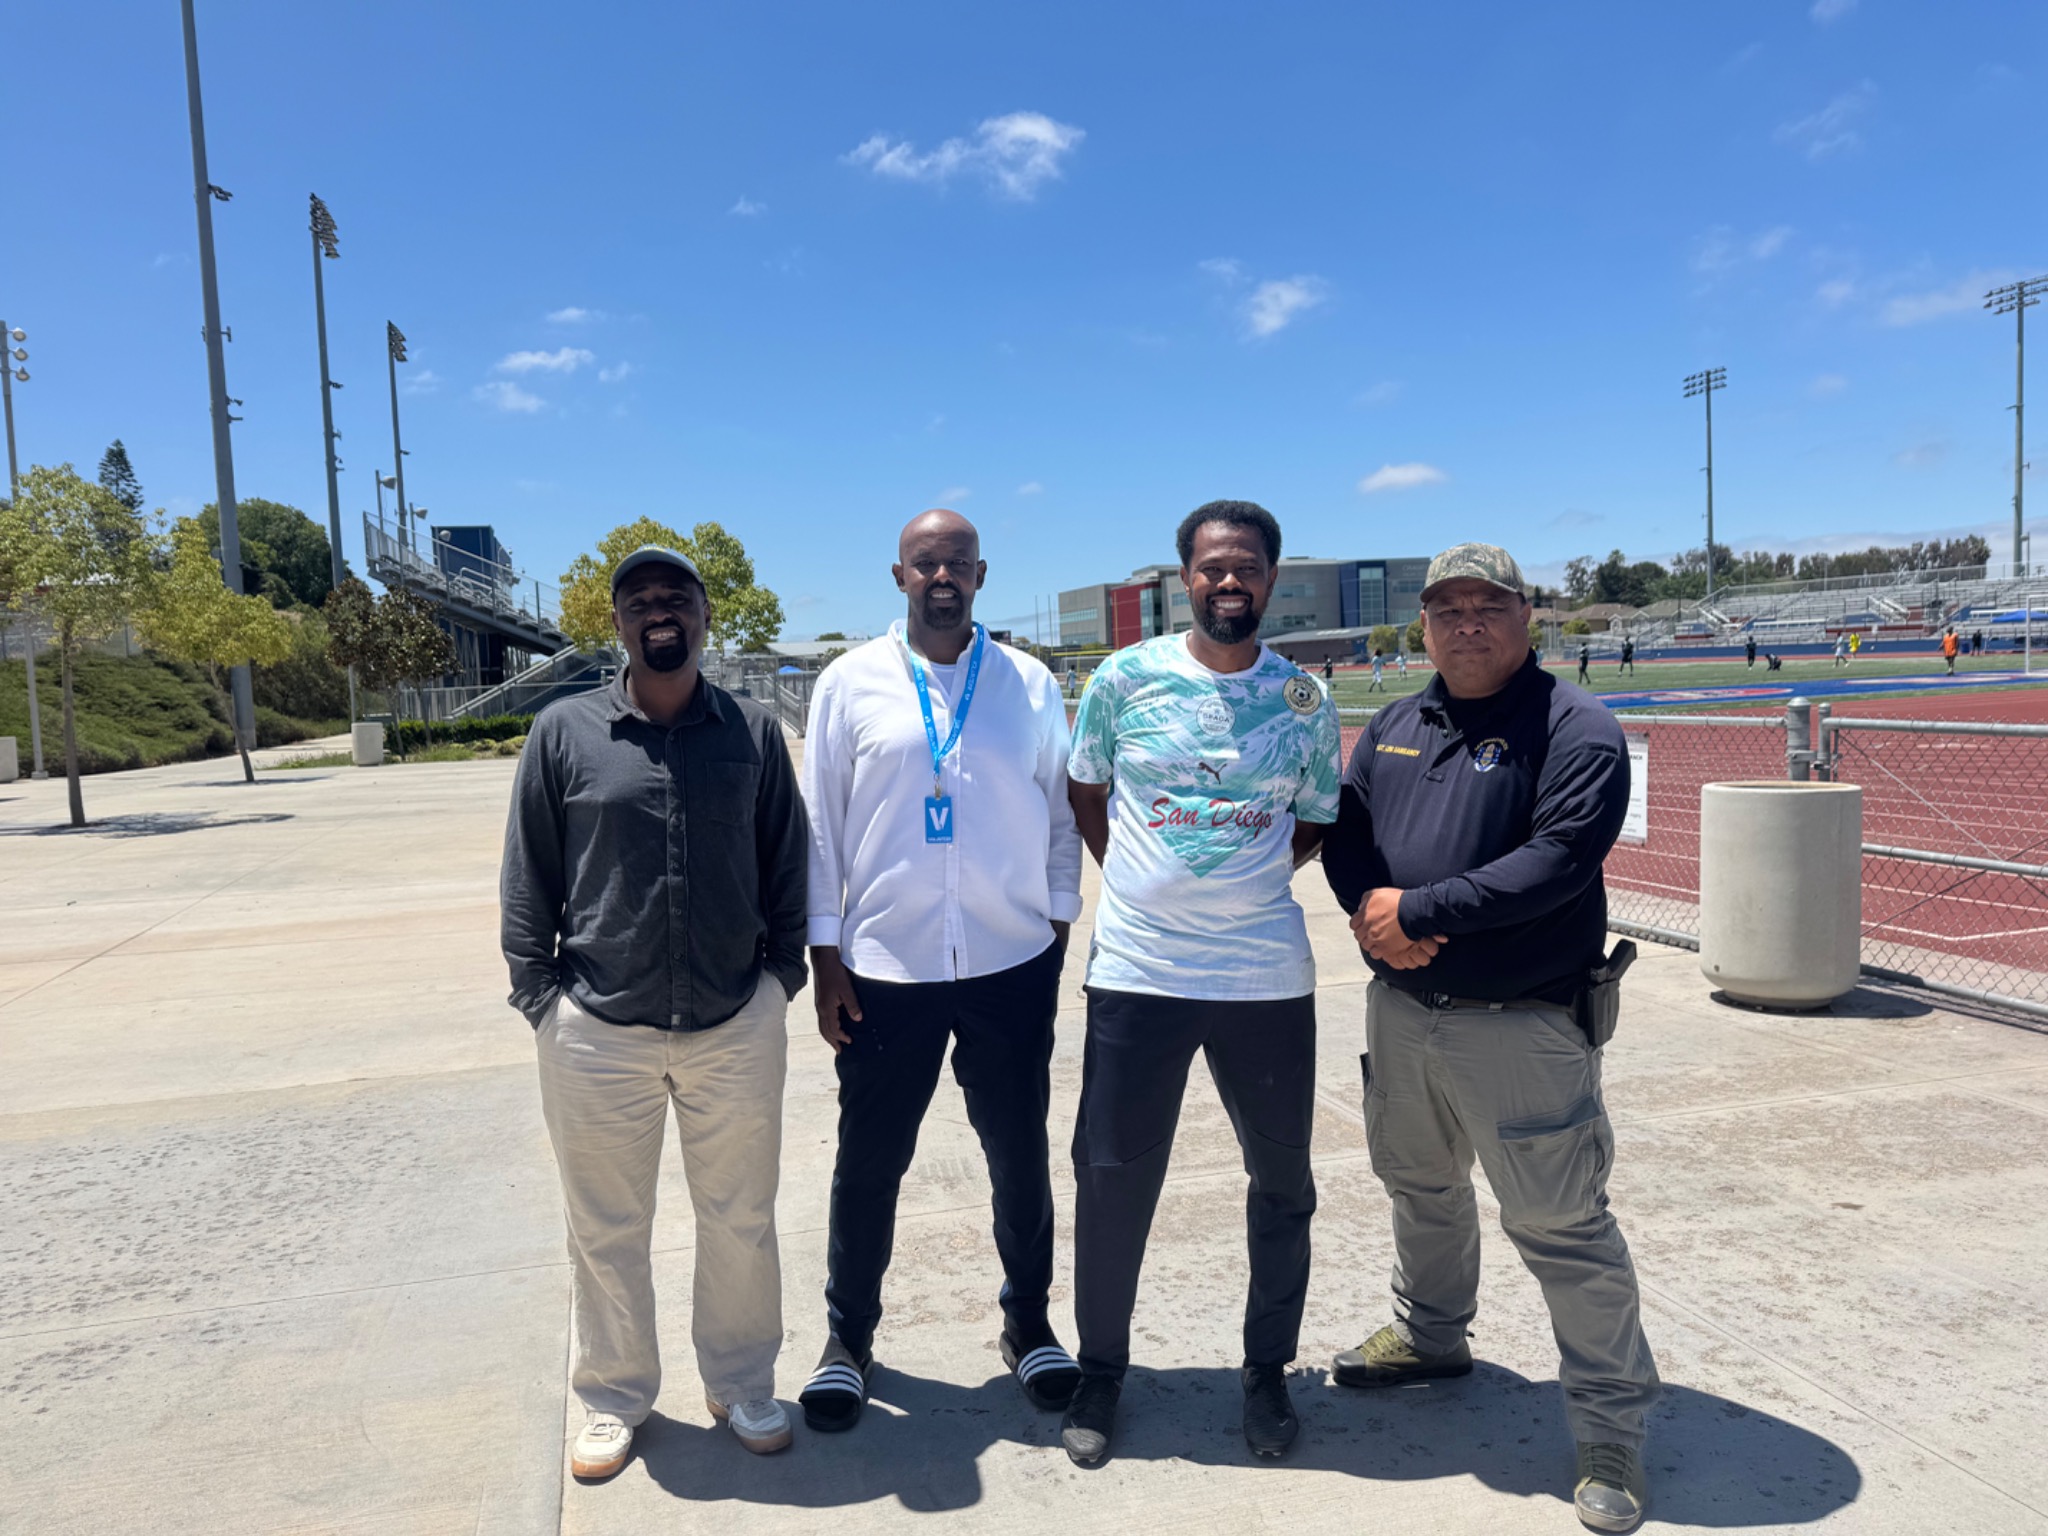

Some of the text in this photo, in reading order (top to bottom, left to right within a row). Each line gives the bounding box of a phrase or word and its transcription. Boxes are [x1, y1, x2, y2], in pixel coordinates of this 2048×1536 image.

[928, 806, 949, 830] V
[1147, 797, 1272, 839] San Diego
